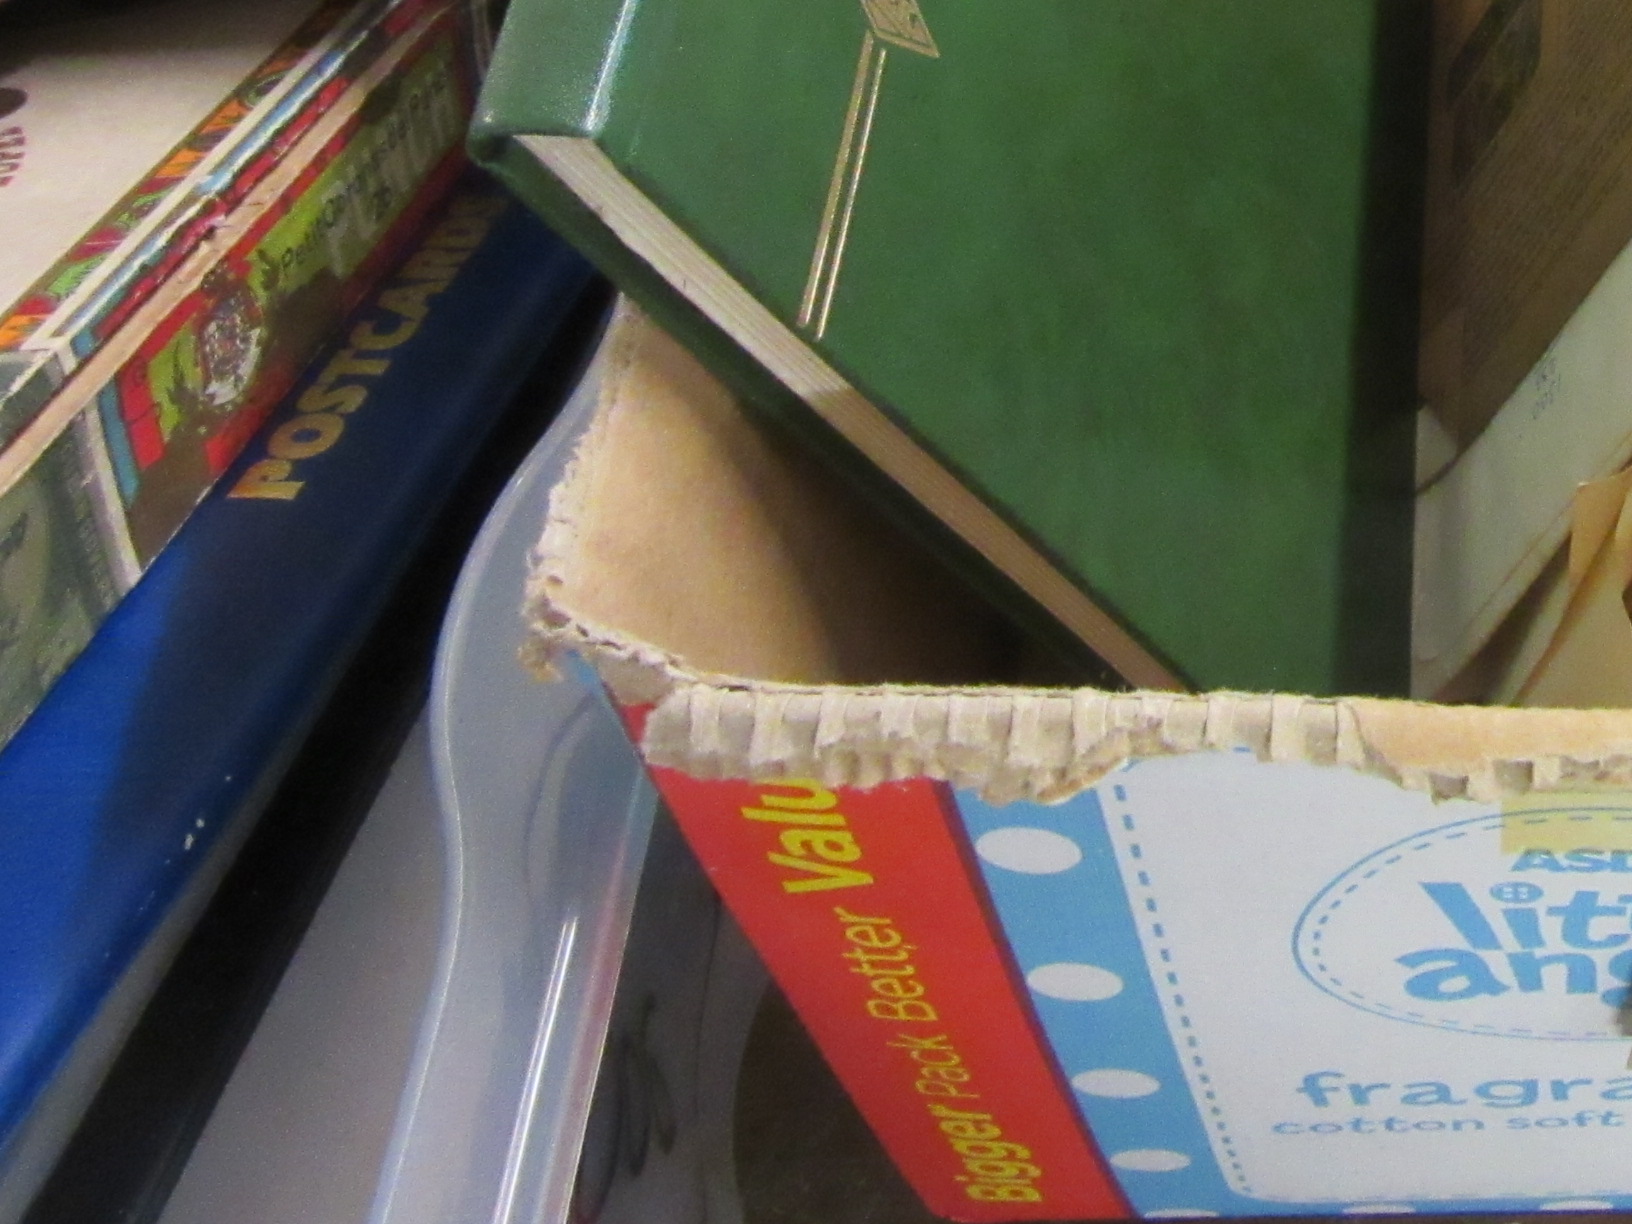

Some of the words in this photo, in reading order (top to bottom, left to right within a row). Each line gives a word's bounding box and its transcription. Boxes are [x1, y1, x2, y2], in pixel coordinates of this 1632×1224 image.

[740, 777, 875, 894] Valu
[832, 905, 940, 1024] Better
[927, 1103, 1044, 1204] Bigger
[1271, 1112, 1487, 1136] cotton
[1504, 1109, 1627, 1131] soft
